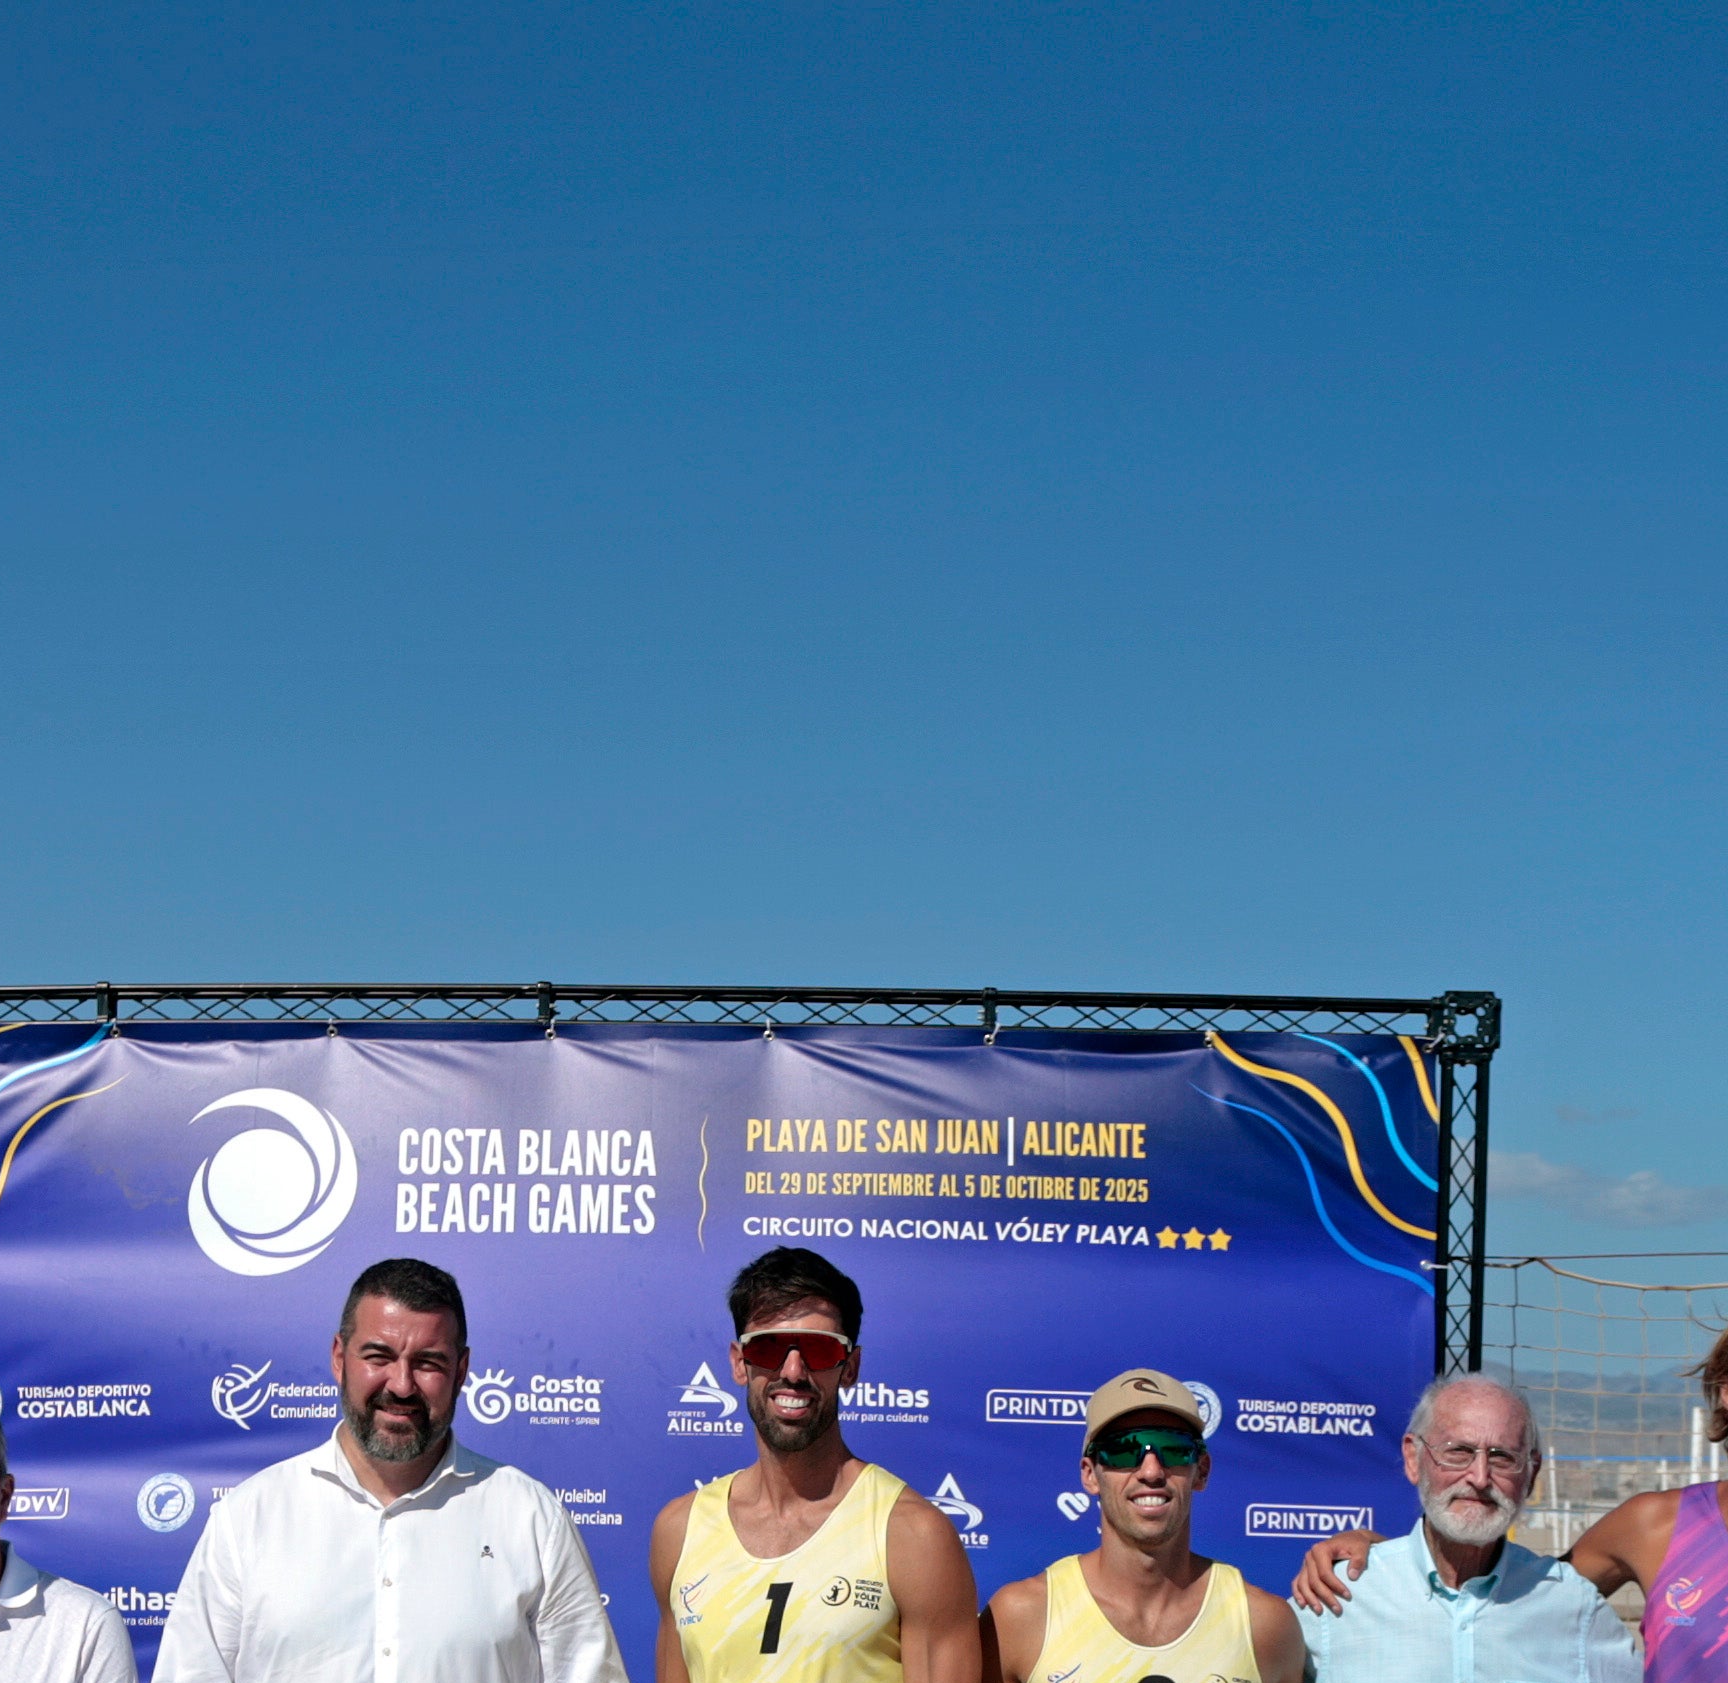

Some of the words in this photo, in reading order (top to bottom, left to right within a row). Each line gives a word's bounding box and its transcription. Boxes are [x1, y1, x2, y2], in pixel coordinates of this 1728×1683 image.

[746, 1118, 828, 1153] PLAYA
[836, 1118, 868, 1153] DE
[875, 1119, 928, 1154] SAN
[934, 1120, 1000, 1155] JUAN
[1022, 1120, 1147, 1159] ALICANTE
[398, 1127, 507, 1176] COSTA
[517, 1128, 657, 1177] BLANCA
[744, 1171, 776, 1195] DEL
[780, 1172, 802, 1195] 29
[806, 1172, 828, 1195] DE
[831, 1172, 935, 1198] SEPTIEMBRE
[939, 1174, 961, 1198] AL
[964, 1174, 976, 1199] 5
[979, 1175, 1001, 1199] DE
[1005, 1175, 1075, 1201] OCTIBRE
[1079, 1177, 1101, 1202] DE
[1104, 1178, 1150, 1204] 2025
[395, 1182, 517, 1234] BEACH
[528, 1182, 657, 1235] GAMES
[743, 1216, 854, 1238] CIRCUITO
[860, 1218, 989, 1241] NACIONAL
[994, 1216, 1071, 1243] VÓLEY
[1075, 1223, 1151, 1247] PLAYA
[17, 1385, 74, 1400] TURISMO
[77, 1383, 152, 1399] DEPORTIVO
[530, 1374, 602, 1395] Costa
[514, 1393, 602, 1413] Blanca
[838, 1382, 930, 1409] vithas
[16, 1399, 152, 1420] COSTABLANCA
[270, 1403, 338, 1420] Comunidad
[860, 1412, 885, 1424] para
[885, 1411, 930, 1424] cuidarte
[1237, 1399, 1298, 1414] TURISMO
[1300, 1401, 1377, 1417] DEPORTIVO
[529, 1416, 570, 1426] ALICANTE
[575, 1416, 601, 1426] SPAIN
[667, 1417, 745, 1434] Alicante
[1235, 1414, 1374, 1437] COSTABLANCA
[555, 1488, 607, 1505] Voleibol
[103, 1586, 177, 1612] ithas
[759, 1581, 794, 1655] 1
